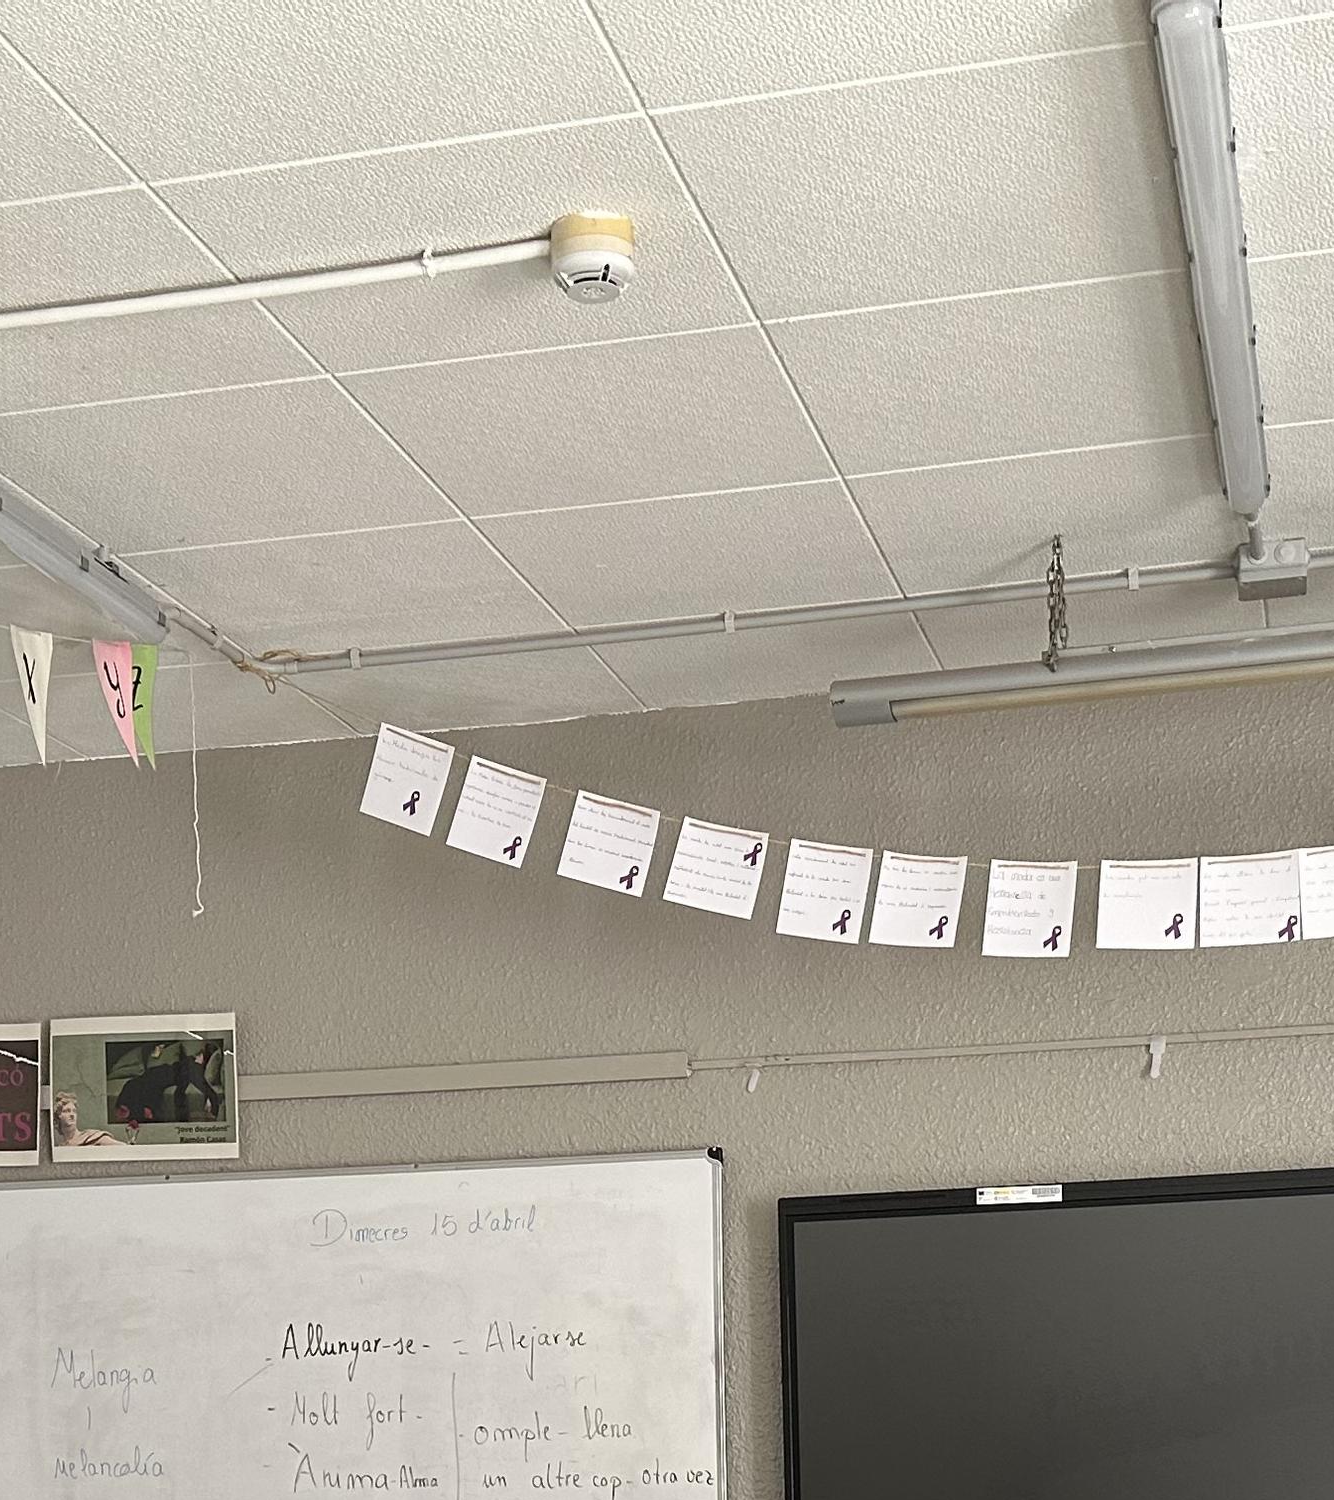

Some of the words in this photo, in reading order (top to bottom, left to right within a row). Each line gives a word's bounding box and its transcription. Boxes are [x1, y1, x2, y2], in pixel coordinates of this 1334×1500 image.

[22, 651, 36, 705] X
[430, 1212, 458, 1237] 15
[485, 1321, 587, 1381] Alejarse
[482, 1471, 507, 1489] un
[531, 1461, 584, 1491] altre
[641, 1458, 679, 1488] otra
[686, 1471, 715, 1488] vez
